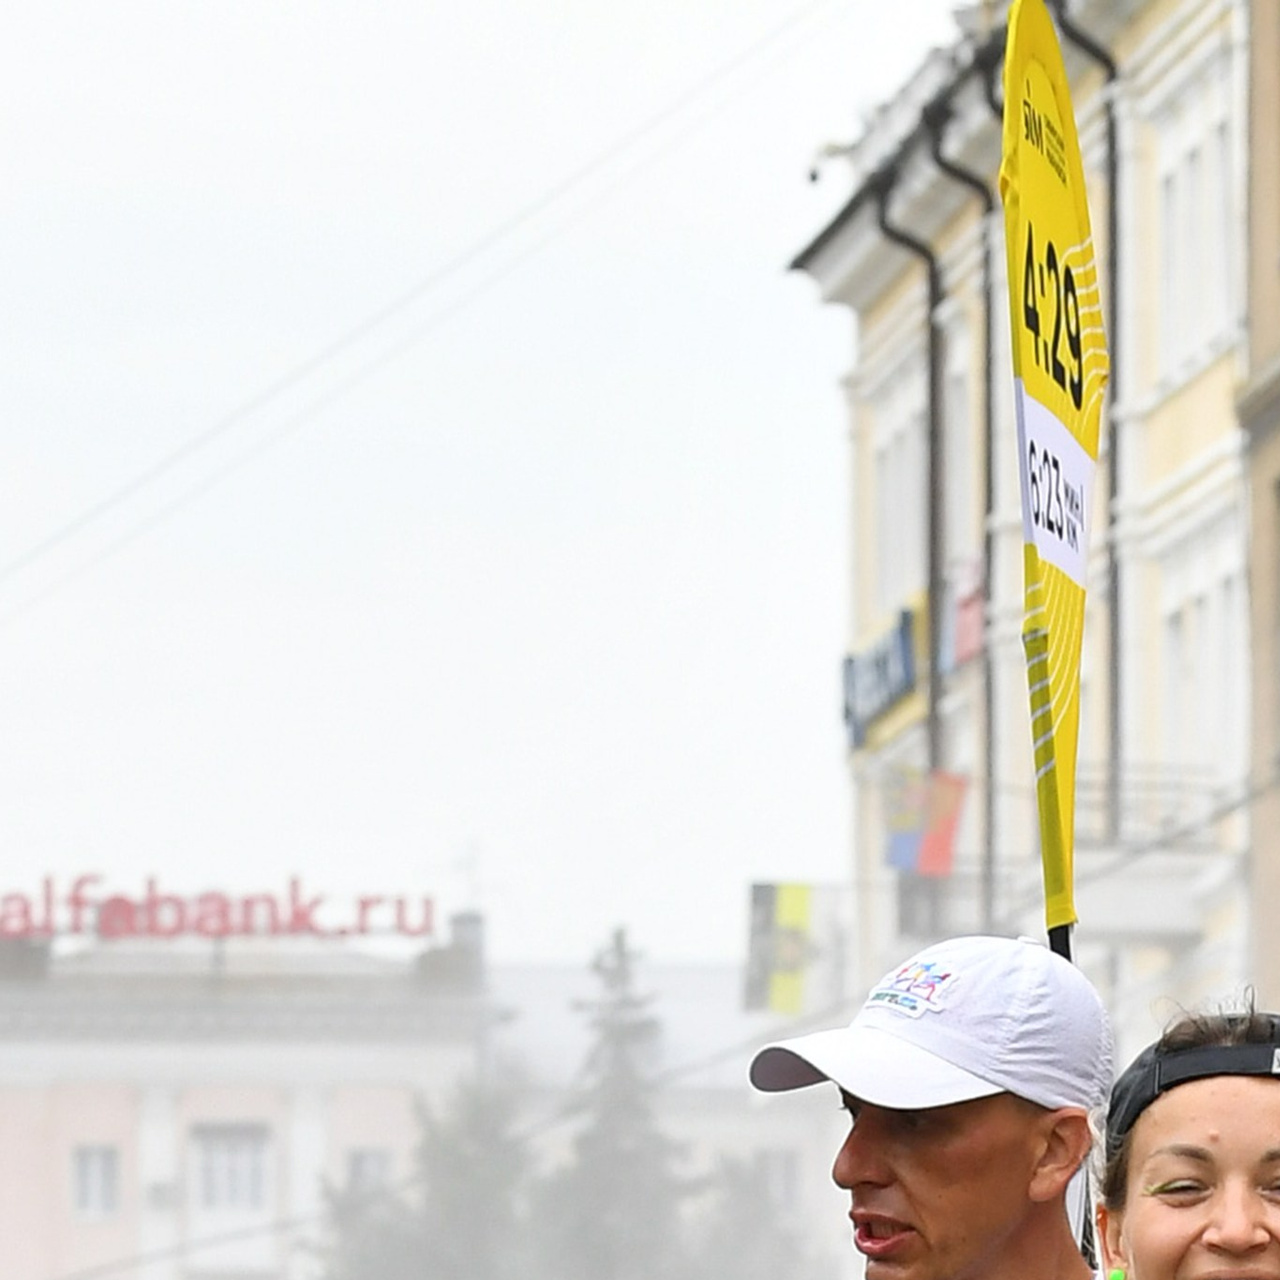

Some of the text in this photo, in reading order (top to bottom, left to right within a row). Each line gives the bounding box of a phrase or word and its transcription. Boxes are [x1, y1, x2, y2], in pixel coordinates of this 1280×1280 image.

[1022, 220, 1084, 411] 4:29
[1028, 438, 1064, 542] 6:23
[0, 874, 437, 940] alfabank.ru
